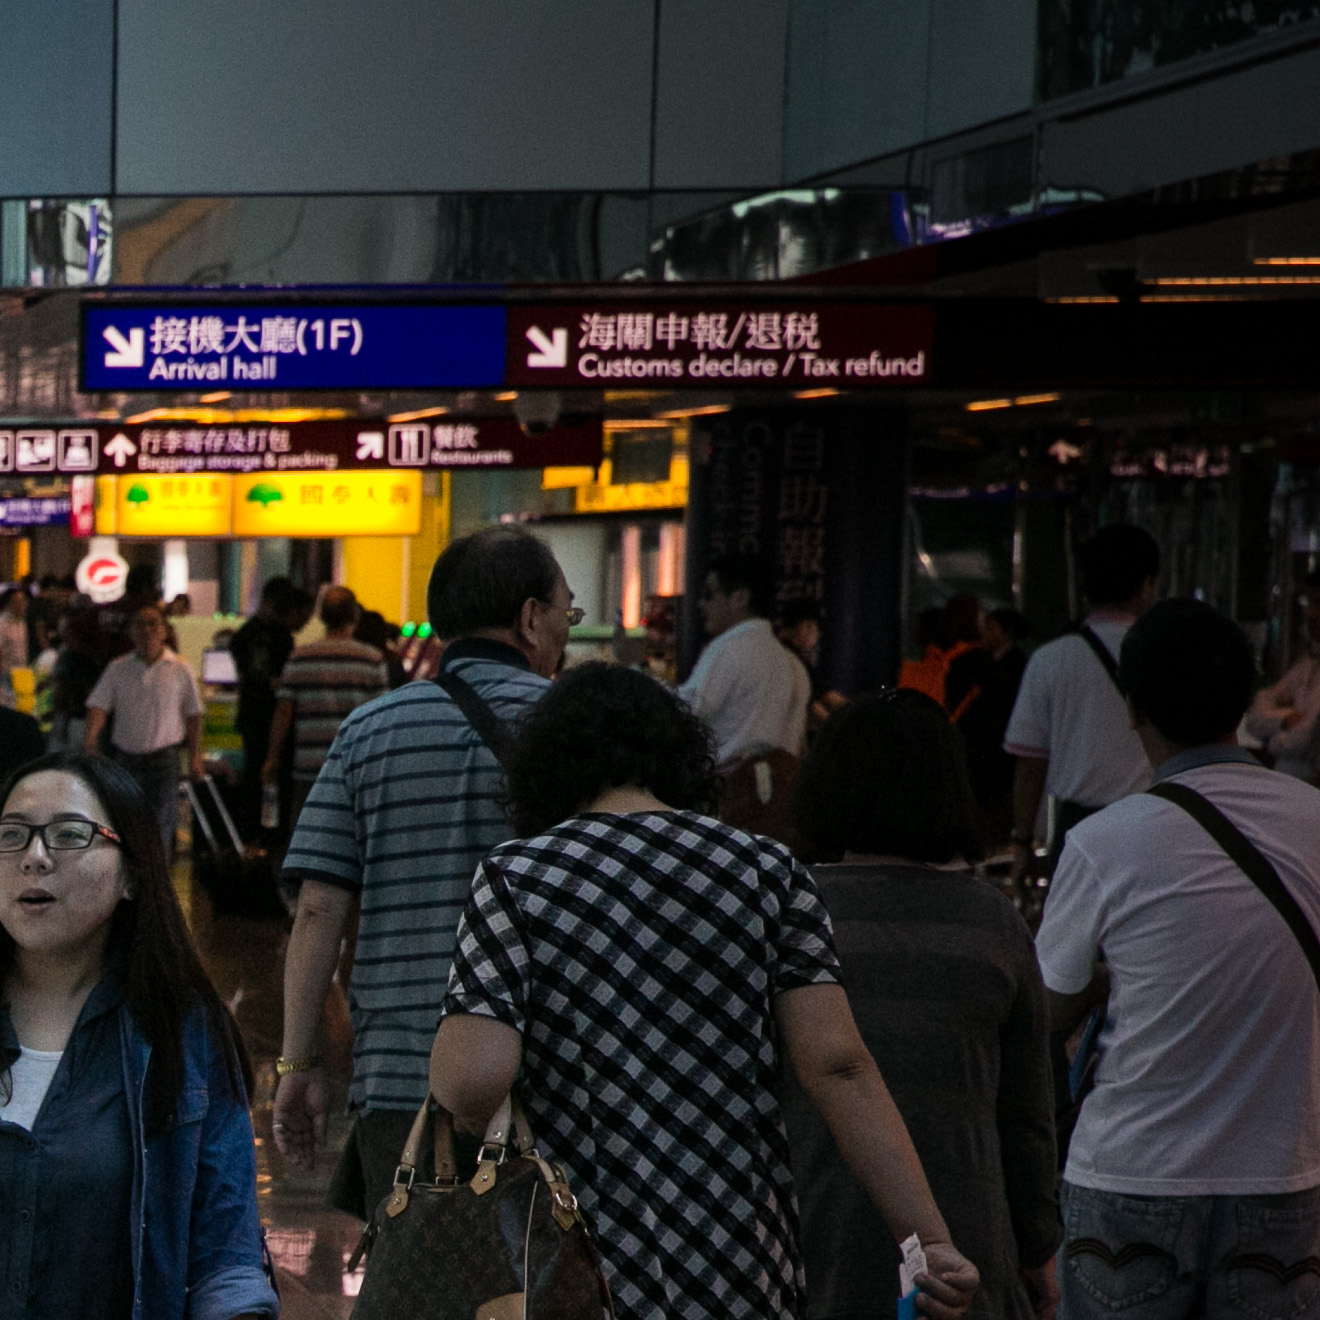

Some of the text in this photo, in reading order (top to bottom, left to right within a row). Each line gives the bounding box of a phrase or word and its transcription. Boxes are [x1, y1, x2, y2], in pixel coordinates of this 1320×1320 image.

[149, 315, 364, 356] 接機大廳(1F)
[148, 355, 278, 381] Arrival hall
[577, 350, 926, 378] Customs declare / Tax refund
[137, 452, 339, 471] Baggage storage & packing
[430, 449, 514, 465] Restaurants
